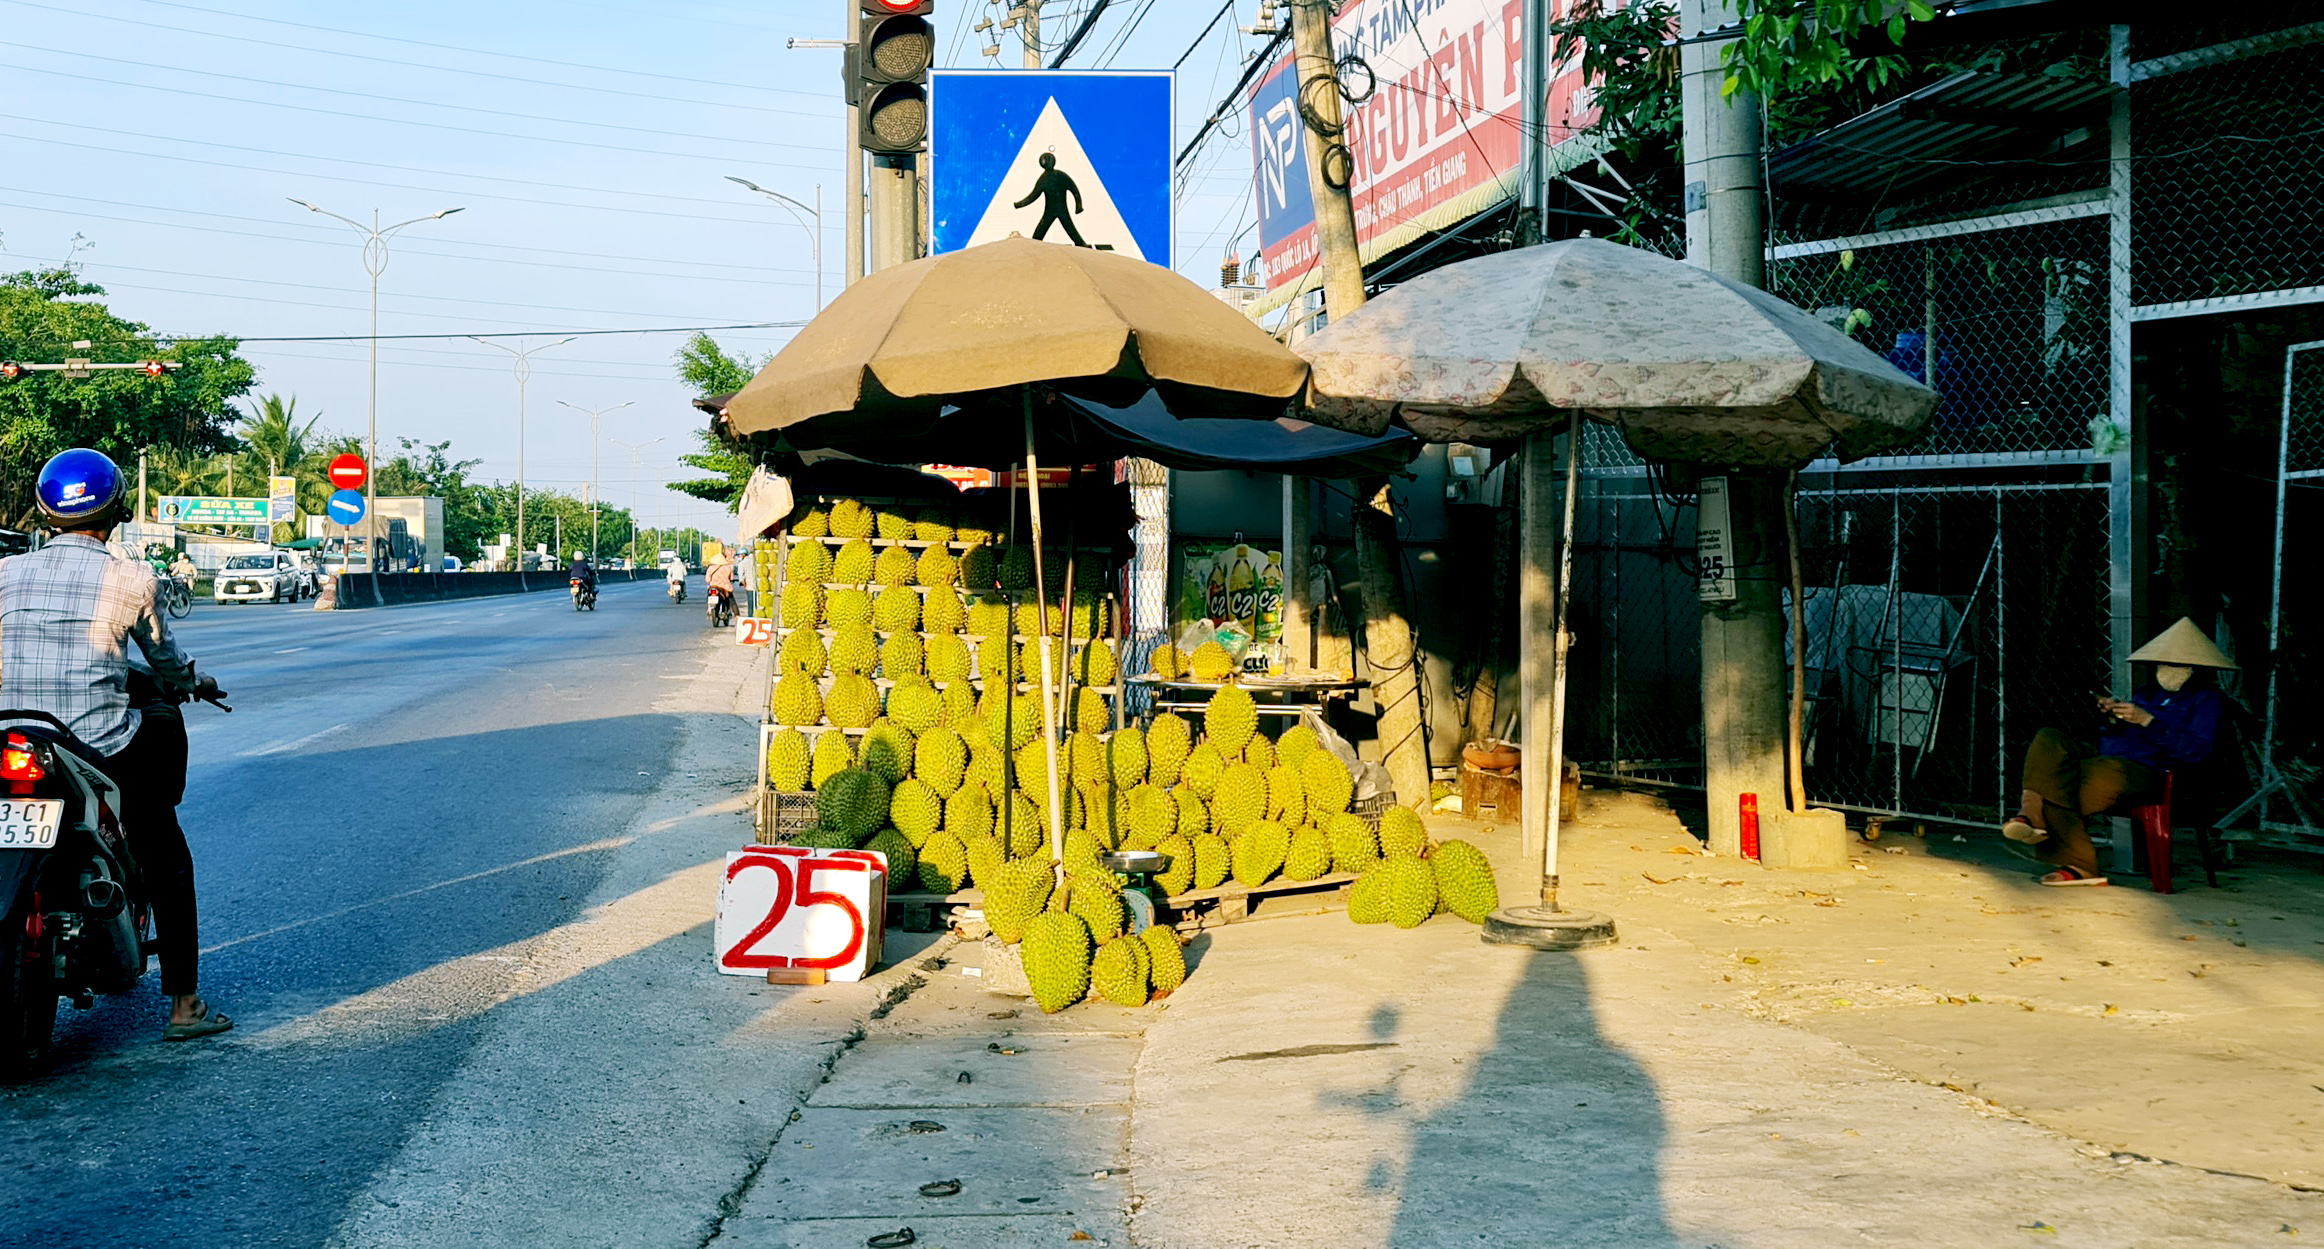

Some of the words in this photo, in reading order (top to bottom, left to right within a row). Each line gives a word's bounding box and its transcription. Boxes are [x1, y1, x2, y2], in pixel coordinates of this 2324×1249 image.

[1348, 20, 1484, 191] NGUYÊN
[1259, 96, 1297, 220] NP
[1272, 255, 1281, 277] 183
[1281, 241, 1294, 274] QUỐC
[1294, 238, 1302, 267] LỘ
[1378, 187, 1397, 220] CHÂU
[1397, 176, 1424, 210] THÀNH,
[1424, 157, 1442, 195] TIỀN
[1442, 150, 1467, 186] GIANG
[57, 495, 95, 507] vinaphone
[200, 500, 231, 509] SỬA
[1211, 595, 1226, 617] C2
[1231, 592, 1253, 618] C2
[1259, 590, 1279, 611] C2
[742, 619, 773, 645] 25
[0, 825, 52, 844] 5.50
[722, 856, 865, 969] 25
